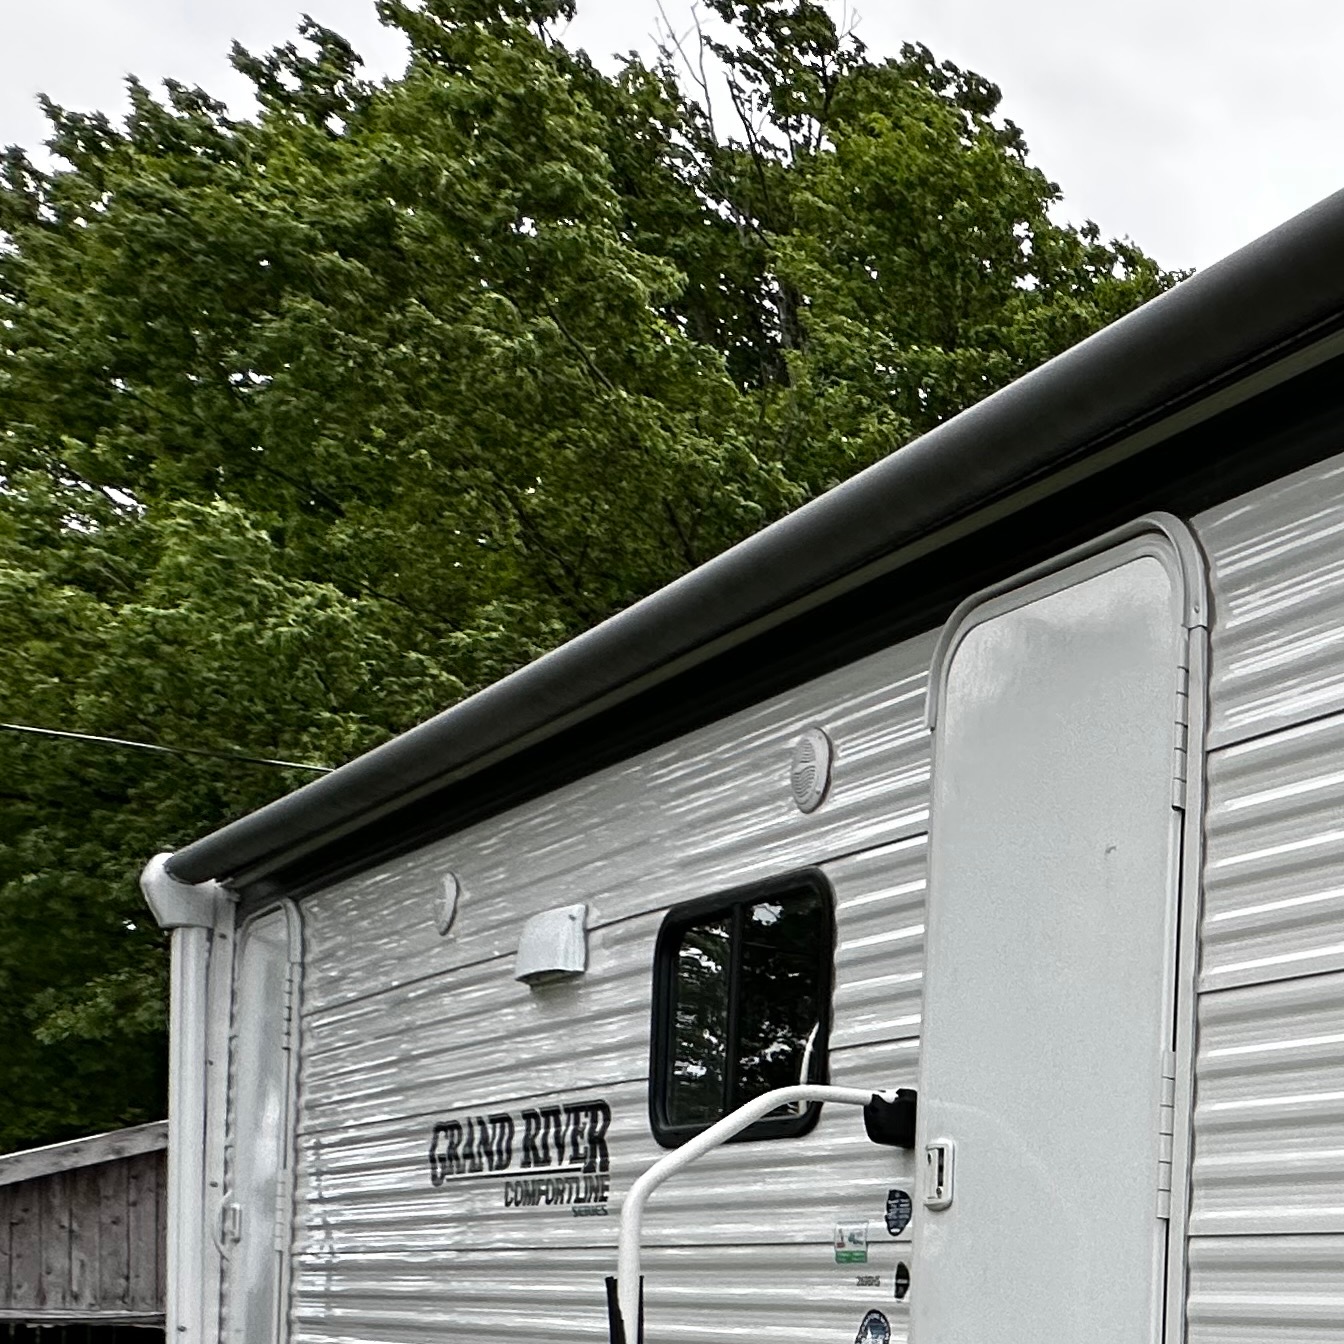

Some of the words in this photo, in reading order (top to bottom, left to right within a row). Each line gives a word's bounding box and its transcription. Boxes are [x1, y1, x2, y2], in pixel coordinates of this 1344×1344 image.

[429, 1114, 515, 1187] GRAND
[520, 1099, 612, 1173] RIVER
[504, 1174, 610, 1207] COMFORTLINE
